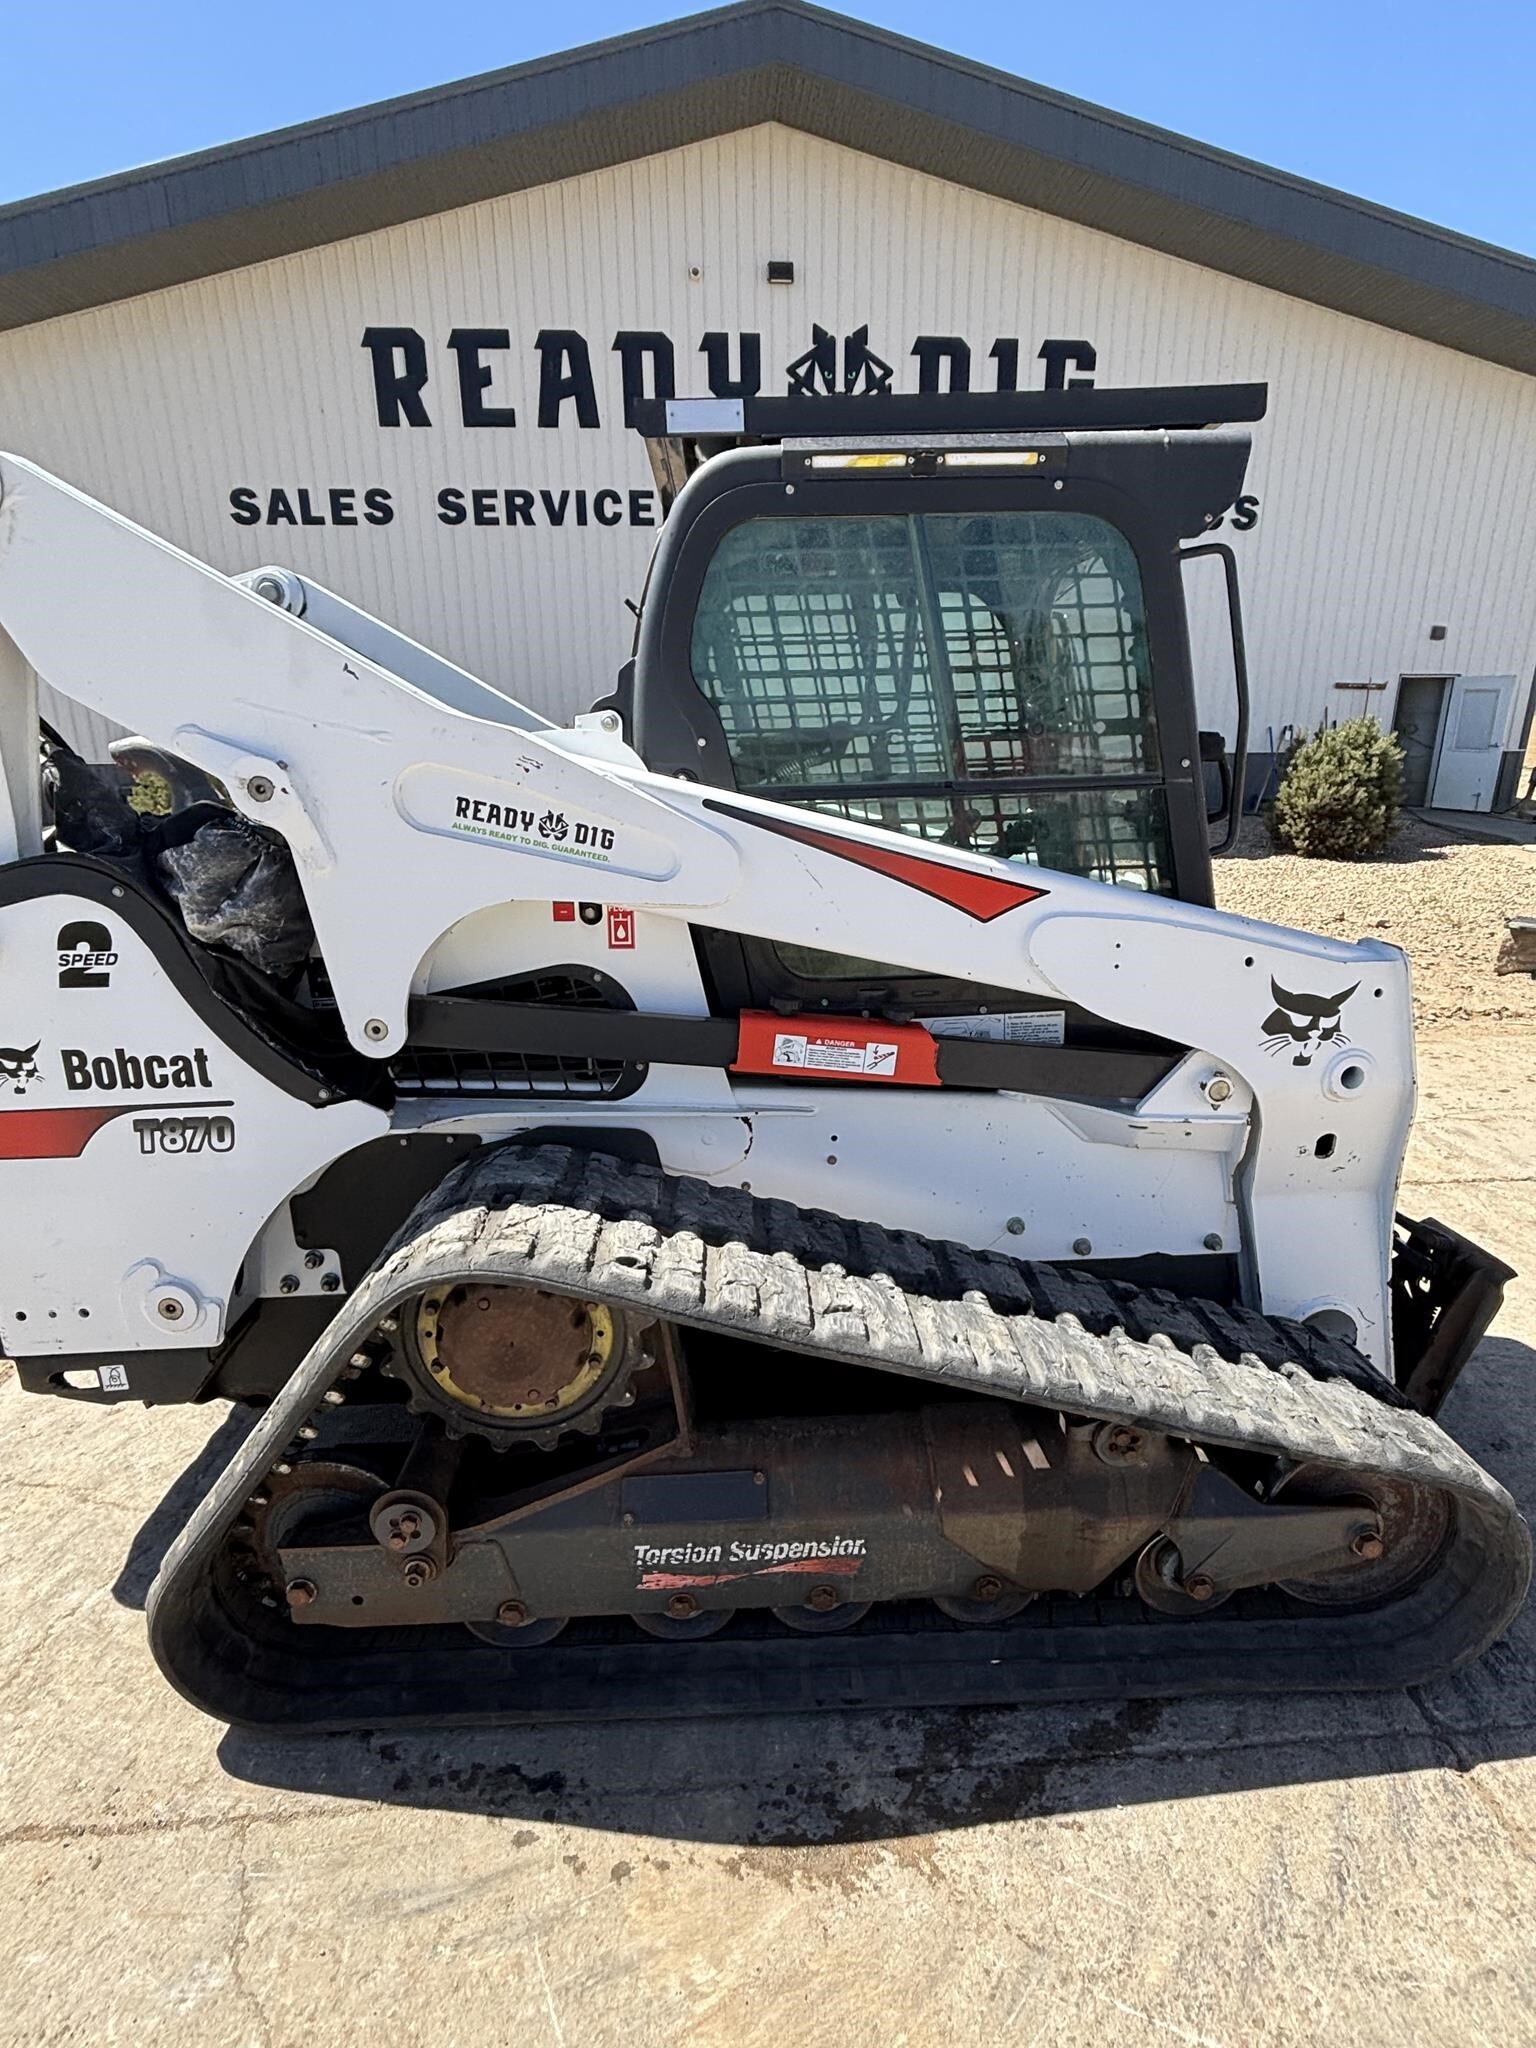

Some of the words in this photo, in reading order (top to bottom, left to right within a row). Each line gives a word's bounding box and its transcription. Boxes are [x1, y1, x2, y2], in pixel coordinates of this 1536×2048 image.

[361, 326, 761, 428] READY
[230, 487, 393, 526] SALES
[438, 488, 656, 526] SERVICE
[451, 822, 488, 836] ALWAYS
[488, 830, 518, 843] READY
[519, 836, 532, 846] TO
[551, 843, 610, 863] GUARANTEED.
[455, 796, 535, 832] READY
[574, 822, 616, 850] DIG
[57, 920, 112, 988] 2
[58, 953, 119, 967] SPEED
[824, 1039, 856, 1048] DANGER
[61, 1048, 213, 1091] Bobcat
[133, 1116, 235, 1155] T870
[634, 1542, 722, 1566] Torsion
[729, 1536, 867, 1563] Suspension
